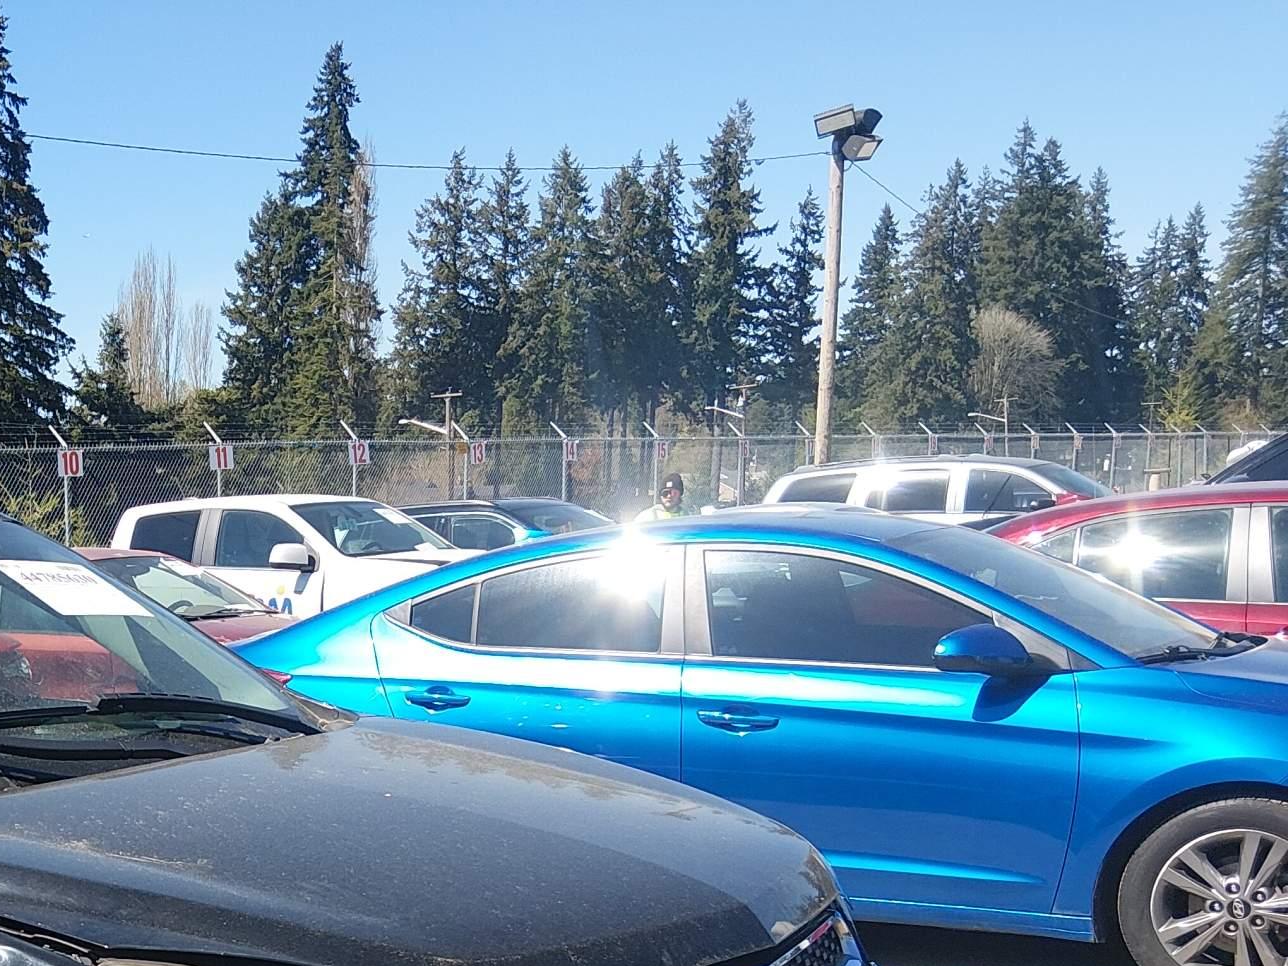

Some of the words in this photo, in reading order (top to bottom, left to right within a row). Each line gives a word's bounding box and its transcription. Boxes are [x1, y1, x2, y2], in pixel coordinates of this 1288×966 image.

[215, 446, 228, 468] 11
[352, 444, 367, 465] 12
[472, 443, 484, 464] 13
[565, 442, 575, 460] 14
[657, 442, 666, 459] 15
[62, 451, 79, 475] 10
